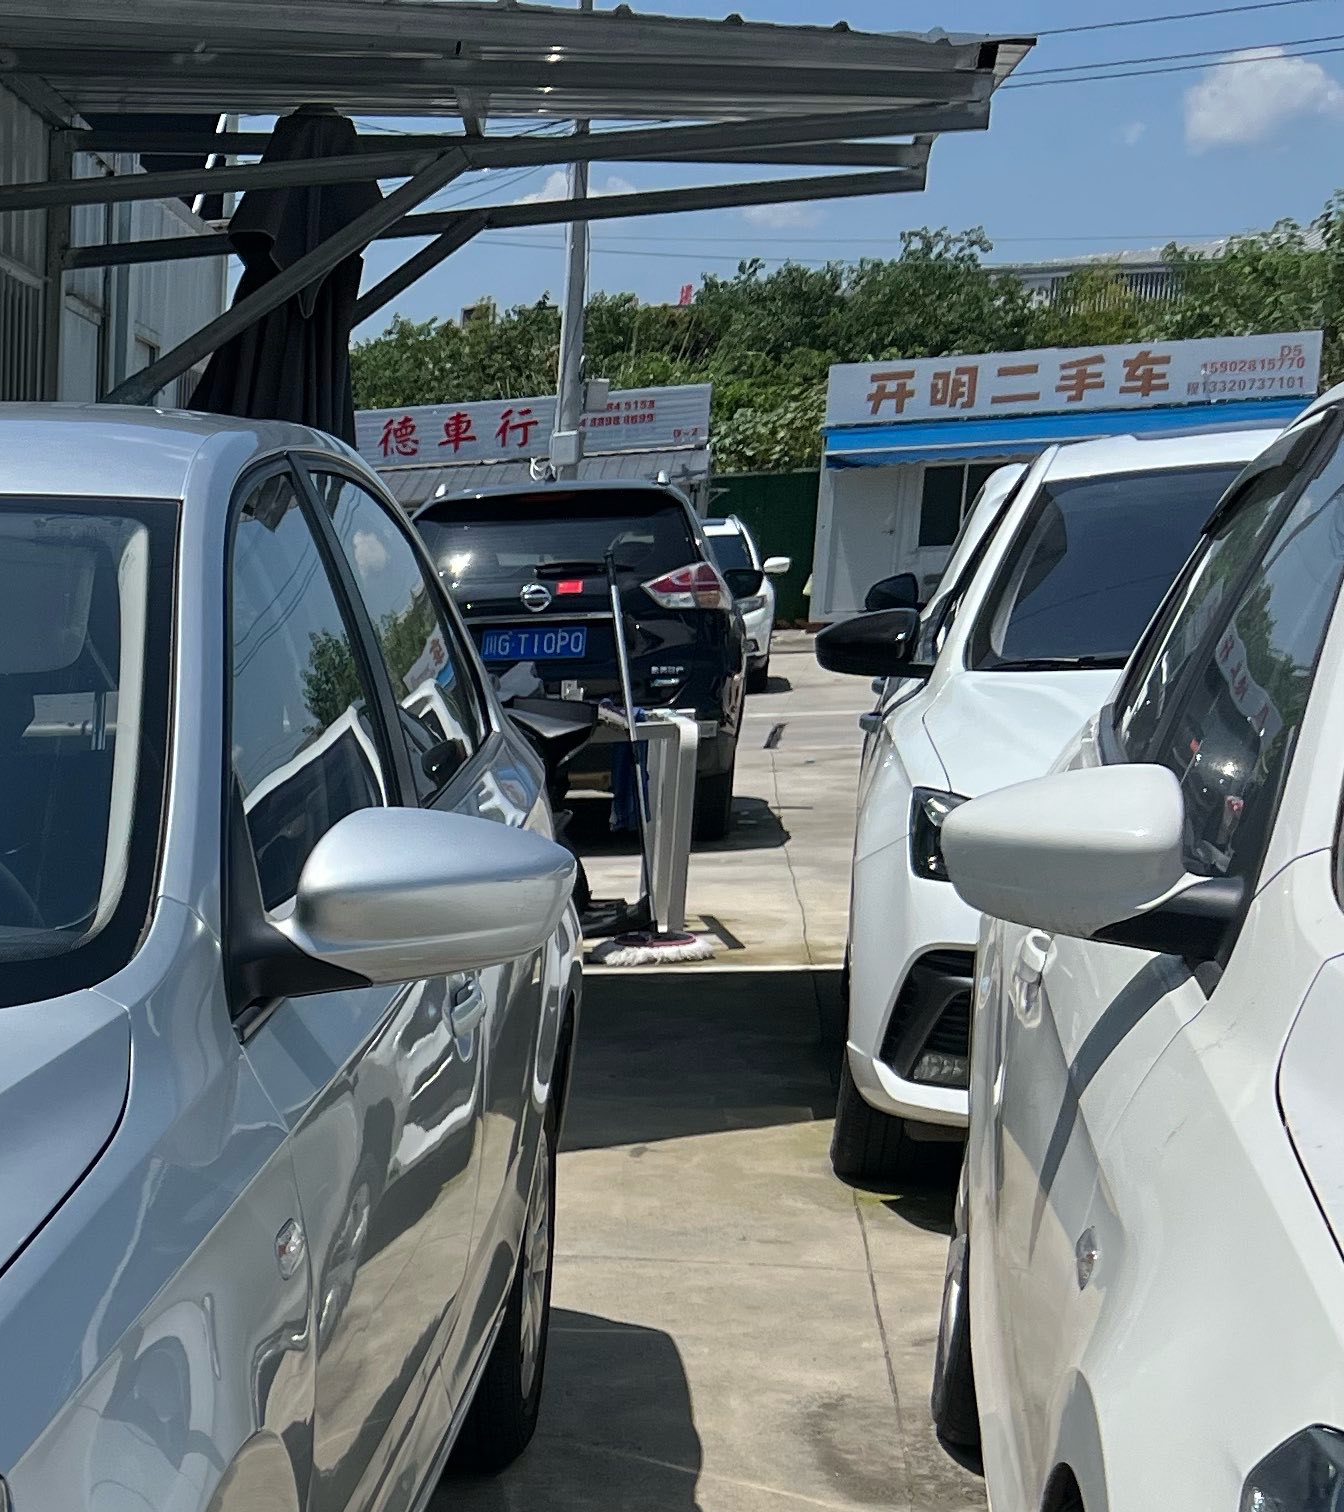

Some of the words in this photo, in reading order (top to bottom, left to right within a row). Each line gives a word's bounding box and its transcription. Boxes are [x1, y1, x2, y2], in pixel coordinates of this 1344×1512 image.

[1279, 345, 1303, 357] D5
[867, 350, 1171, 414] 开明二手车
[378, 407, 539, 457] 德車行
